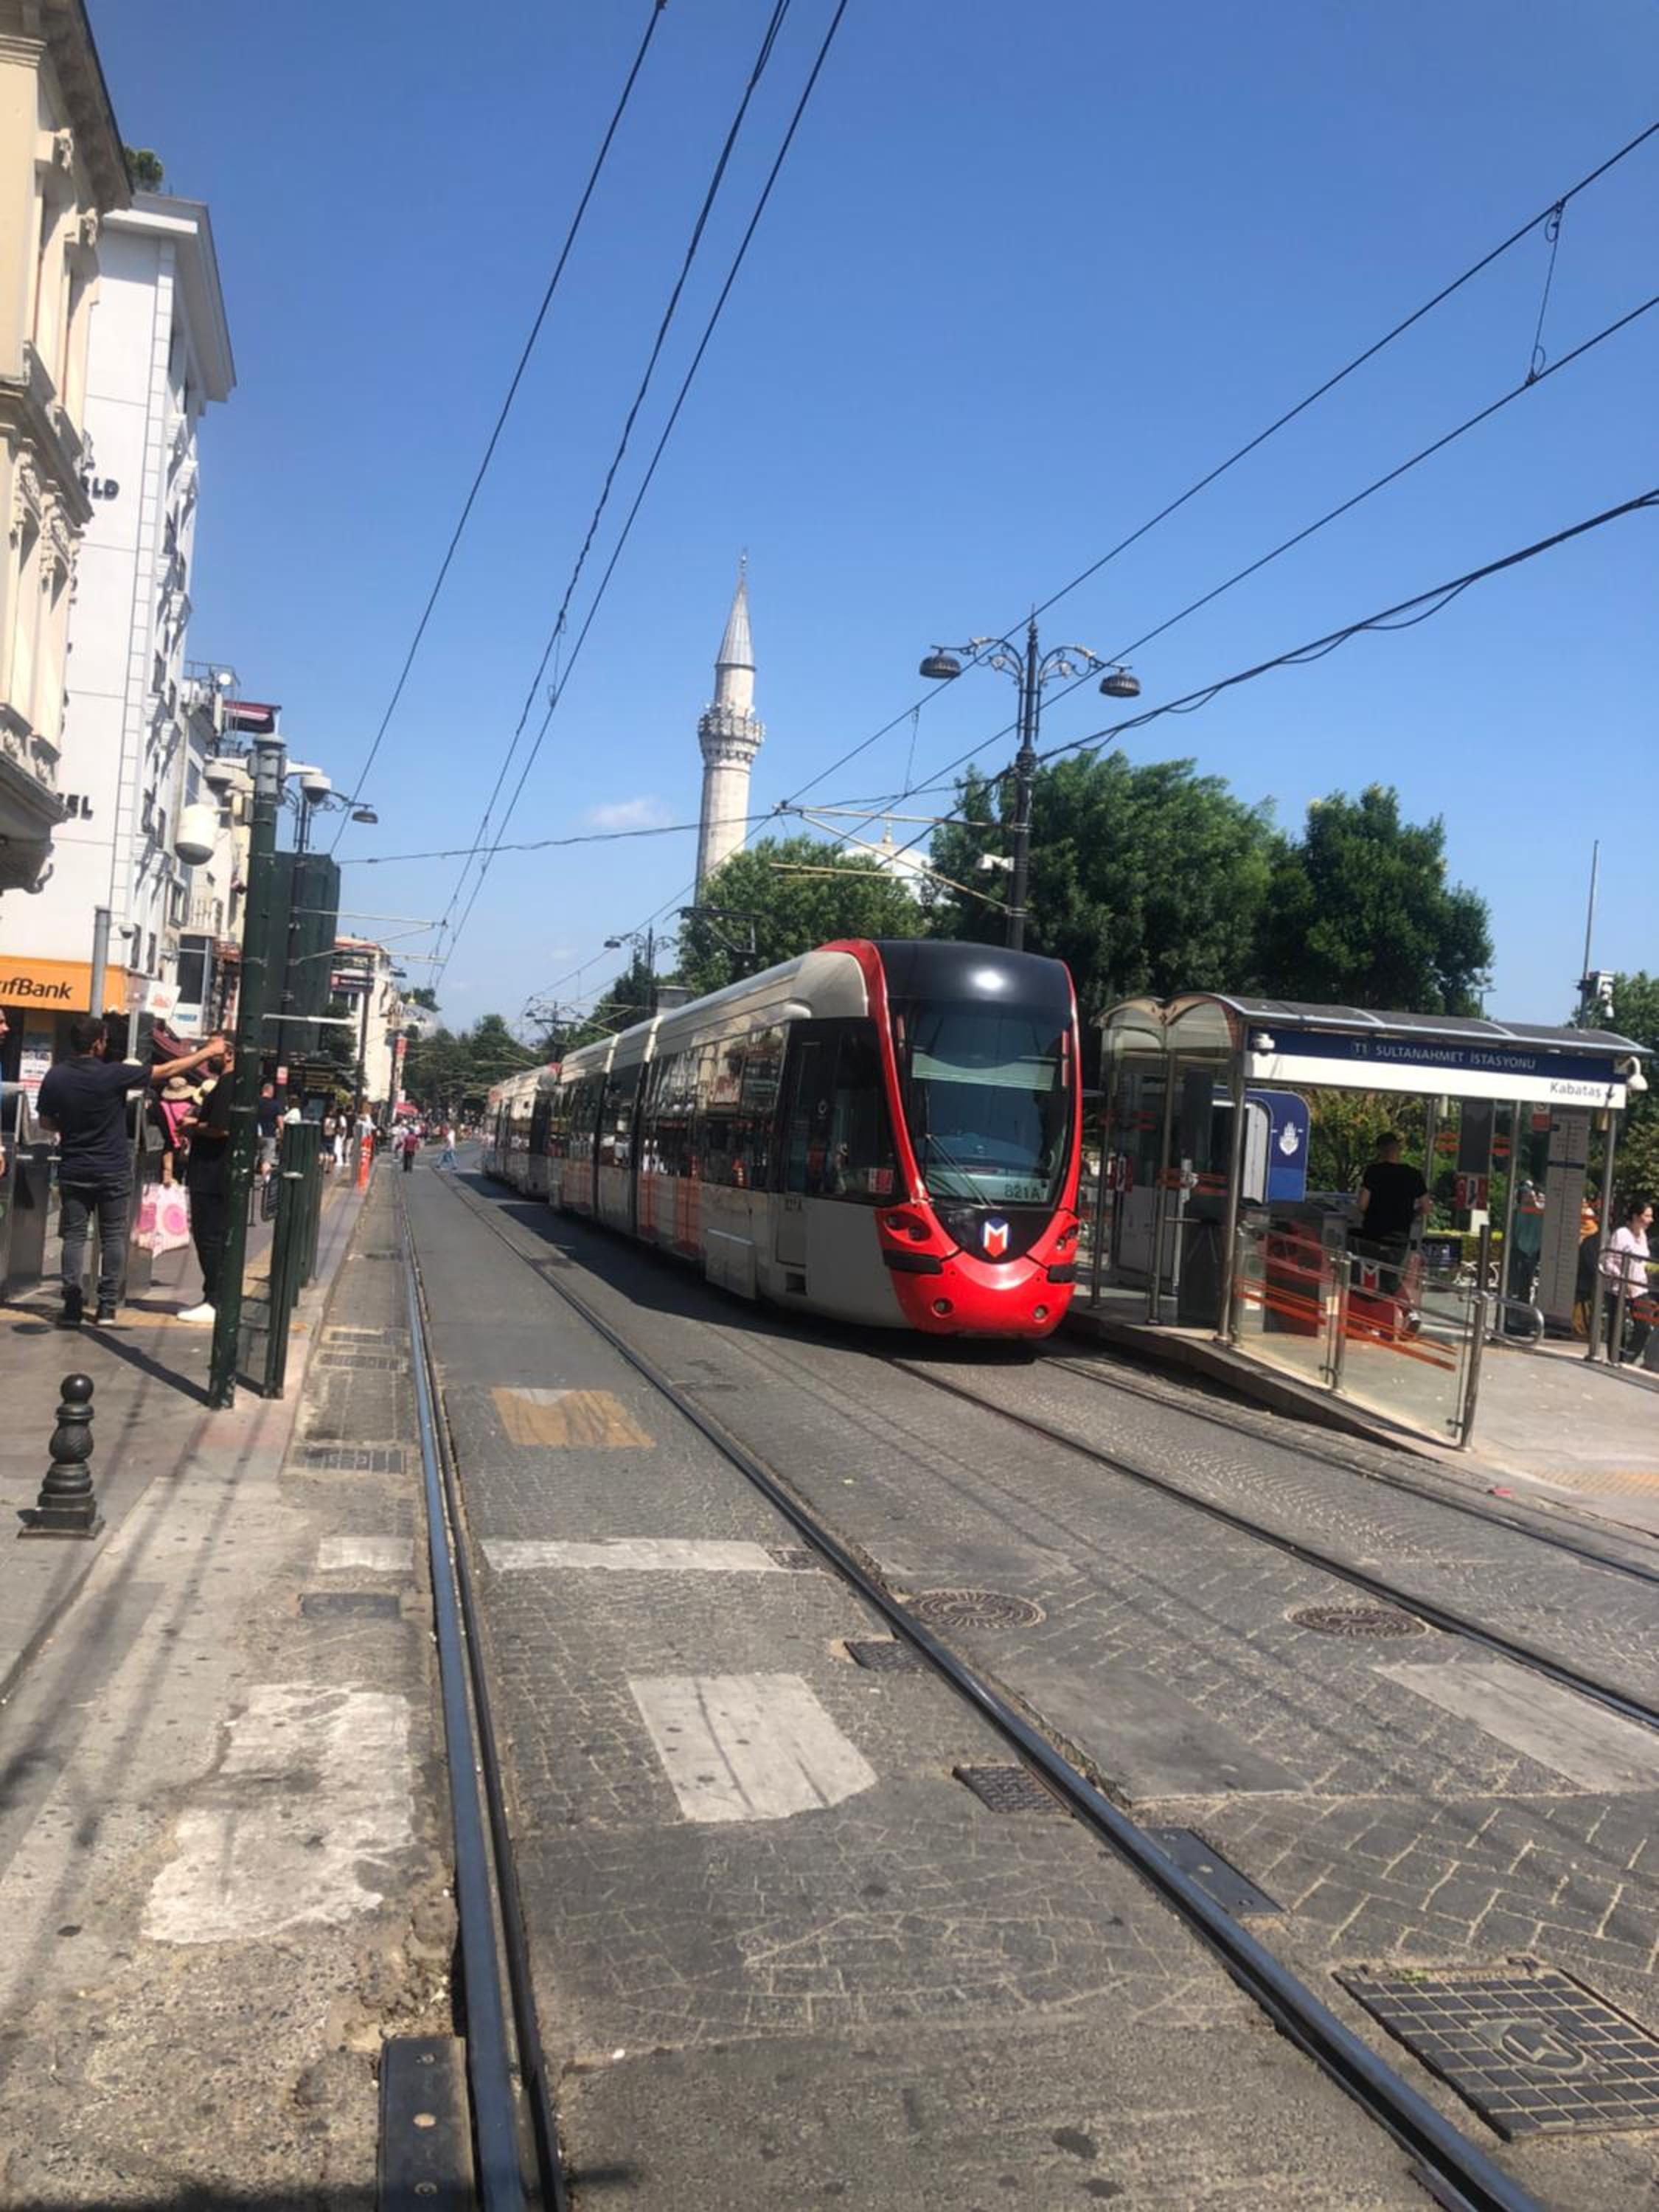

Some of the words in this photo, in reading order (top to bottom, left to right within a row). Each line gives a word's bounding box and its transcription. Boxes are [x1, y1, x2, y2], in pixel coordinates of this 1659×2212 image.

[0, 977, 73, 999] ıfBank
[1376, 1045, 1464, 1062] SULTANAHMET
[984, 1221, 1009, 1251] M
